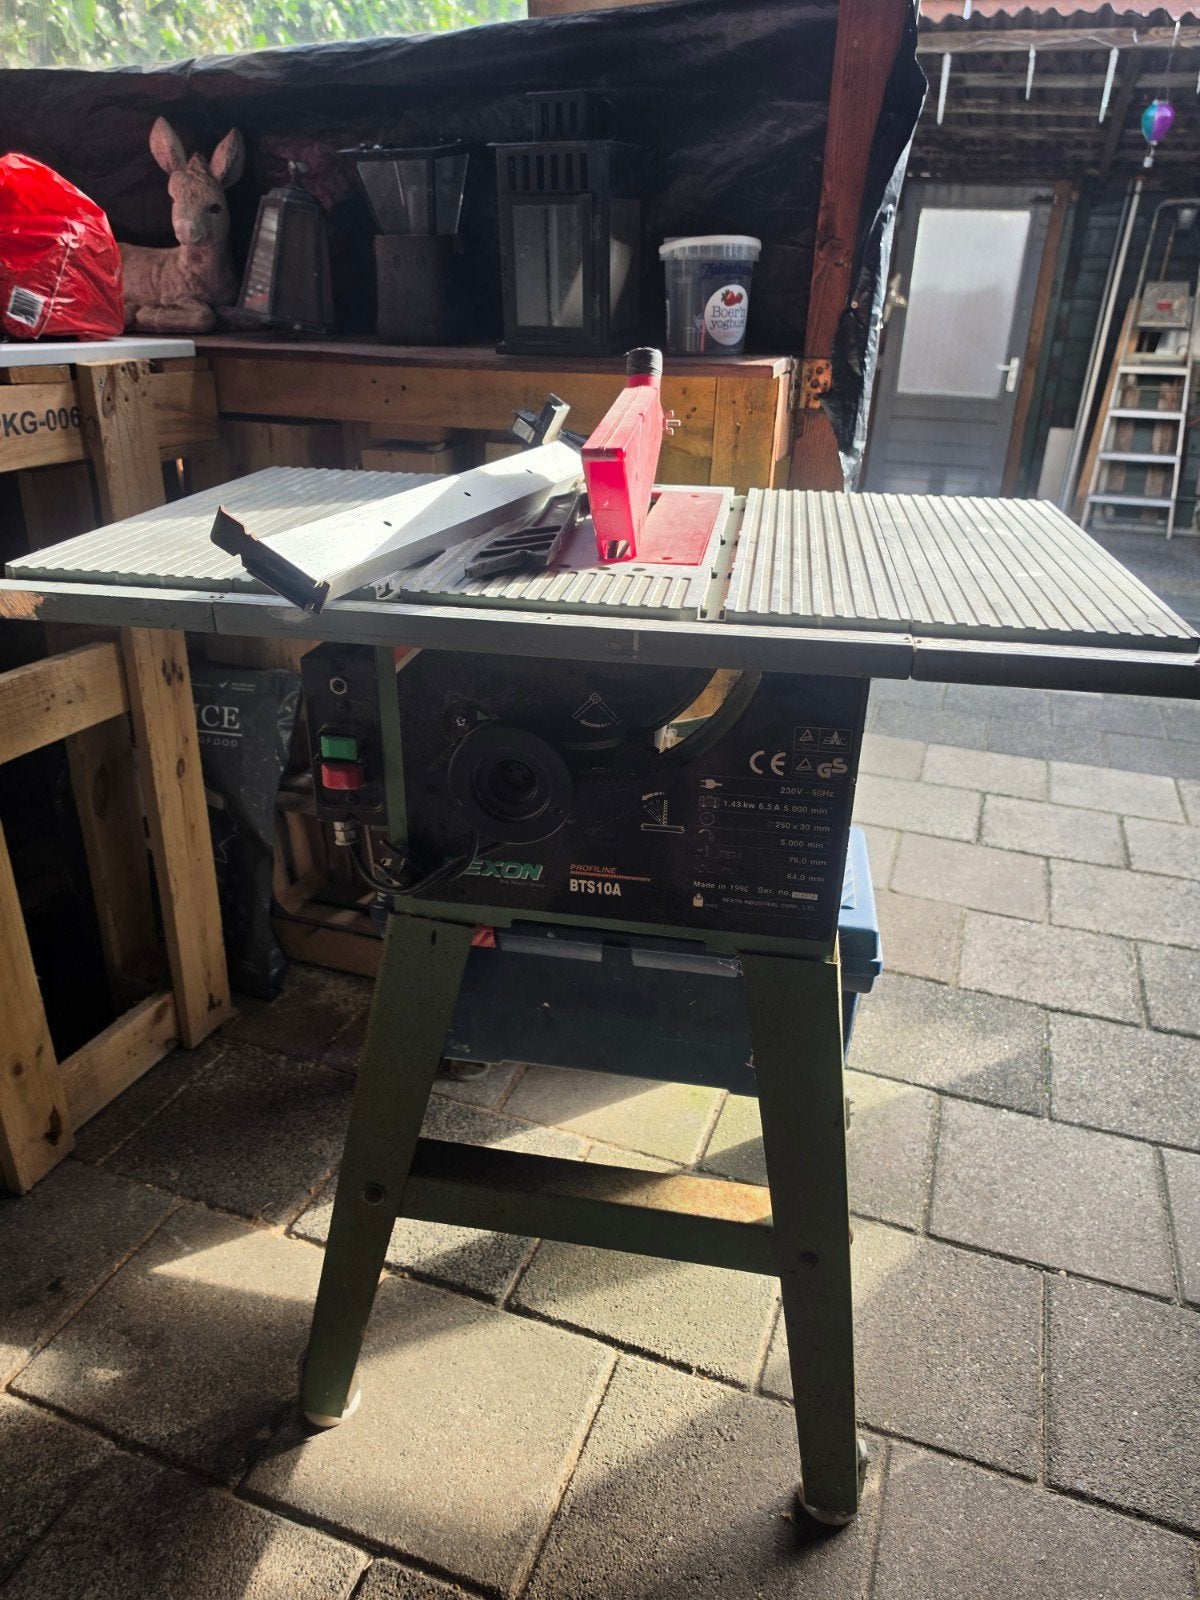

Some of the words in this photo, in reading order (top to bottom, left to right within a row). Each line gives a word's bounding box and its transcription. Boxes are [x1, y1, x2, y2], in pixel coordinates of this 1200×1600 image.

[0, 406, 81, 438] KG-006
[194, 703, 240, 730] CE
[749, 750, 786, 776] CE
[817, 758, 848, 778] GS
[780, 786, 803, 795] 230V
[811, 789, 836, 798] 50Hz
[723, 800, 742, 809] 1.43
[758, 802, 773, 811] 6.5
[783, 805, 808, 813] 5.000
[799, 823, 811, 831] 30
[780, 839, 804, 848] 5.000
[788, 856, 807, 865] 76.0
[460, 857, 544, 882] EXON
[570, 863, 617, 874] PROFILINE
[786, 873, 804, 882] 64.0
[569, 879, 622, 896] BTS10A
[693, 880, 715, 889] Made
[718, 882, 727, 890] in
[758, 886, 775, 895] Ser.
